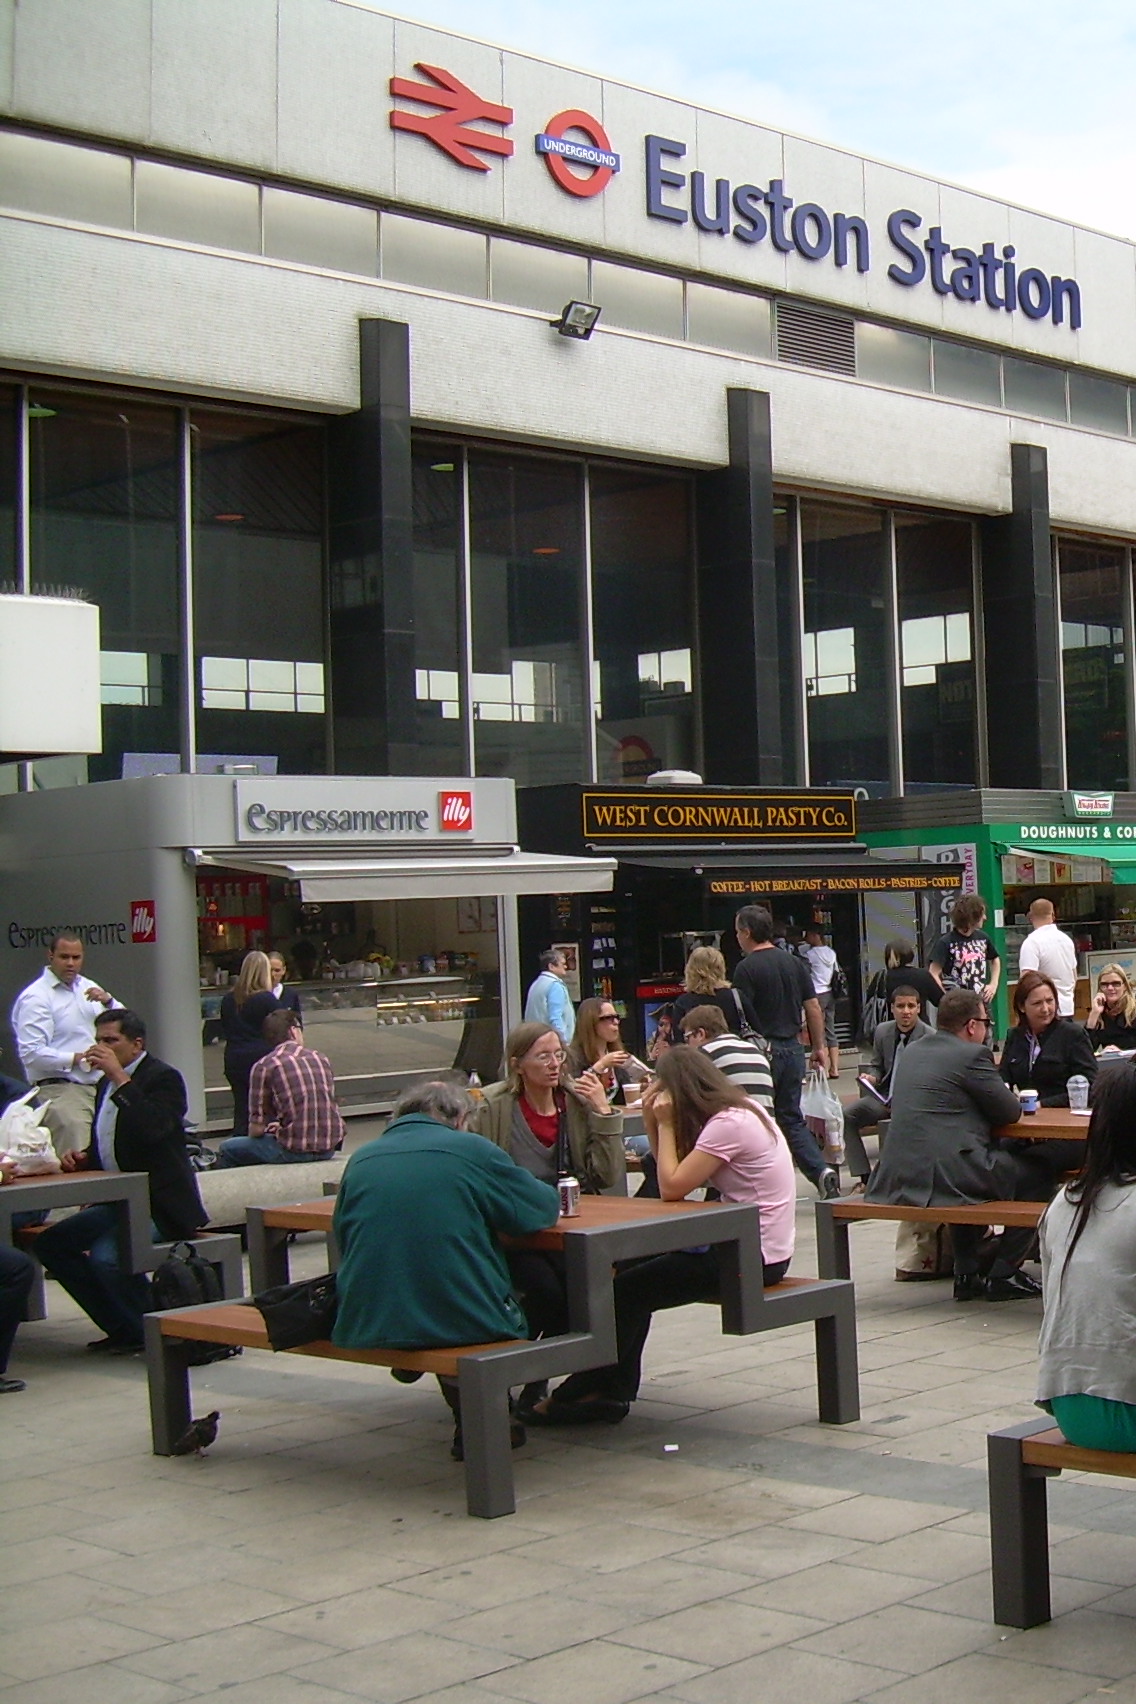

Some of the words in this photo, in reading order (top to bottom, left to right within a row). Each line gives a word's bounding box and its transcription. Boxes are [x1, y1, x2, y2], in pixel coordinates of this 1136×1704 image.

[543, 138, 617, 167] UNDERGROUND
[645, 133, 869, 274] Euston
[886, 208, 1082, 330] Station
[246, 802, 430, 833] espressamente
[442, 796, 471, 828] illy
[593, 805, 650, 828] WEST
[653, 805, 763, 828] CORNWALL
[766, 806, 821, 828] PASTY
[1020, 825, 1099, 839] DOUGHNUTS
[1102, 826, 1112, 839] &
[711, 880, 746, 893] COFFEE
[750, 880, 772, 892] HOT
[772, 879, 822, 892] BREAKFAST
[827, 878, 858, 890] BACON
[859, 877, 886, 889] ROLLS
[932, 876, 960, 888] COFFEE
[963, 847, 974, 894] VERYDAY
[132, 906, 154, 939] illy
